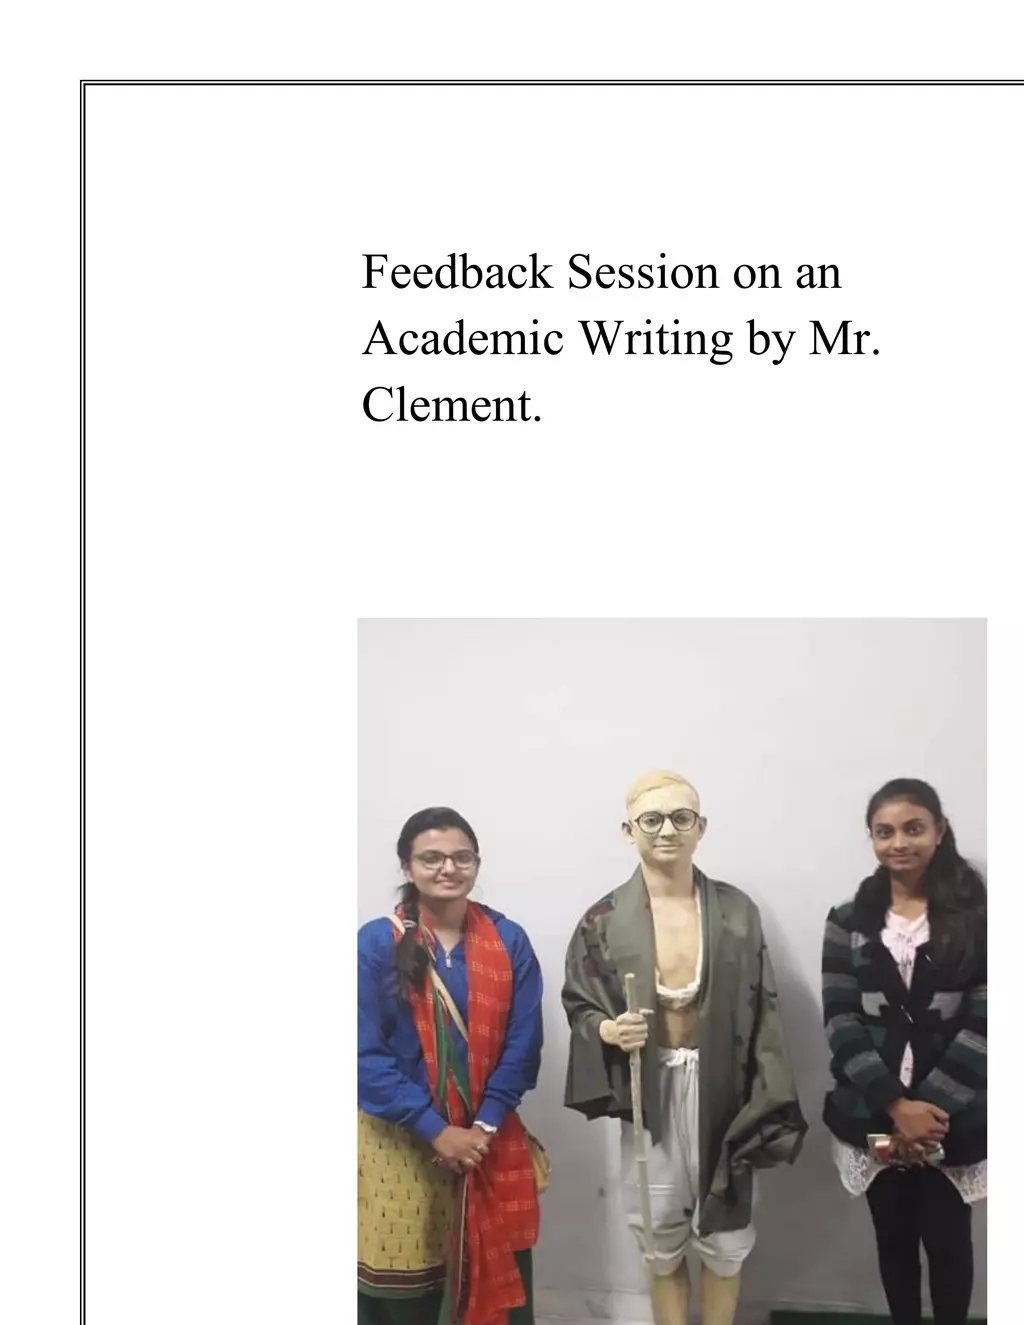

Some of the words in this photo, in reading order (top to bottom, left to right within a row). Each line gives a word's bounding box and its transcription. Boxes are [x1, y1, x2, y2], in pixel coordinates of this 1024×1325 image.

[362, 253, 554, 289] Feedback
[569, 253, 719, 289] Session
[734, 265, 782, 289] on
[797, 265, 842, 289] an
[362, 319, 563, 355] Academic
[578, 319, 733, 365] Writing
[747, 319, 796, 365] by
[810, 321, 880, 355] Mr.
[363, 386, 541, 422] Clement.
